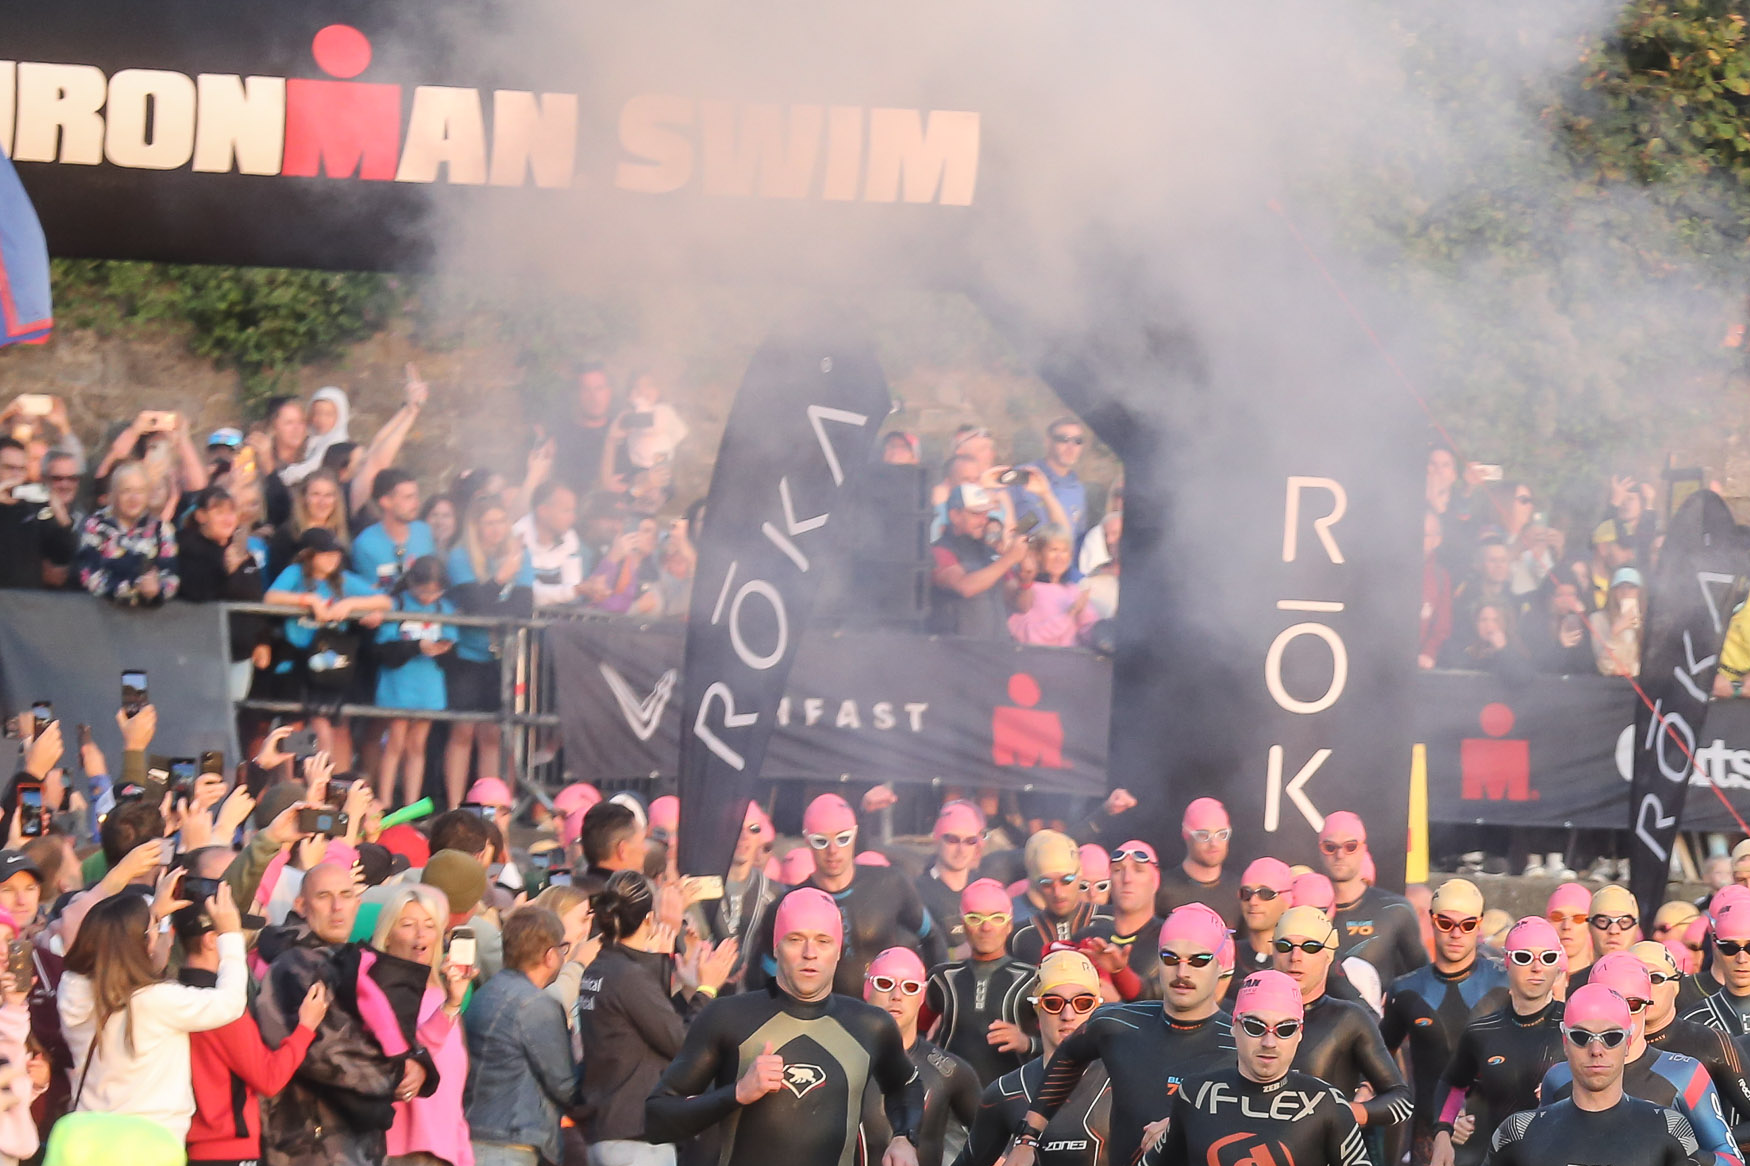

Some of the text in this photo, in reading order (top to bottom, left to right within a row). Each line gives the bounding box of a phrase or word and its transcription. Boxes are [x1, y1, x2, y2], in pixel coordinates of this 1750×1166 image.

[615, 95, 981, 206] SWIM
[1346, 925, 1375, 937] 70
[1042, 1139, 1088, 1152] ZONE3
